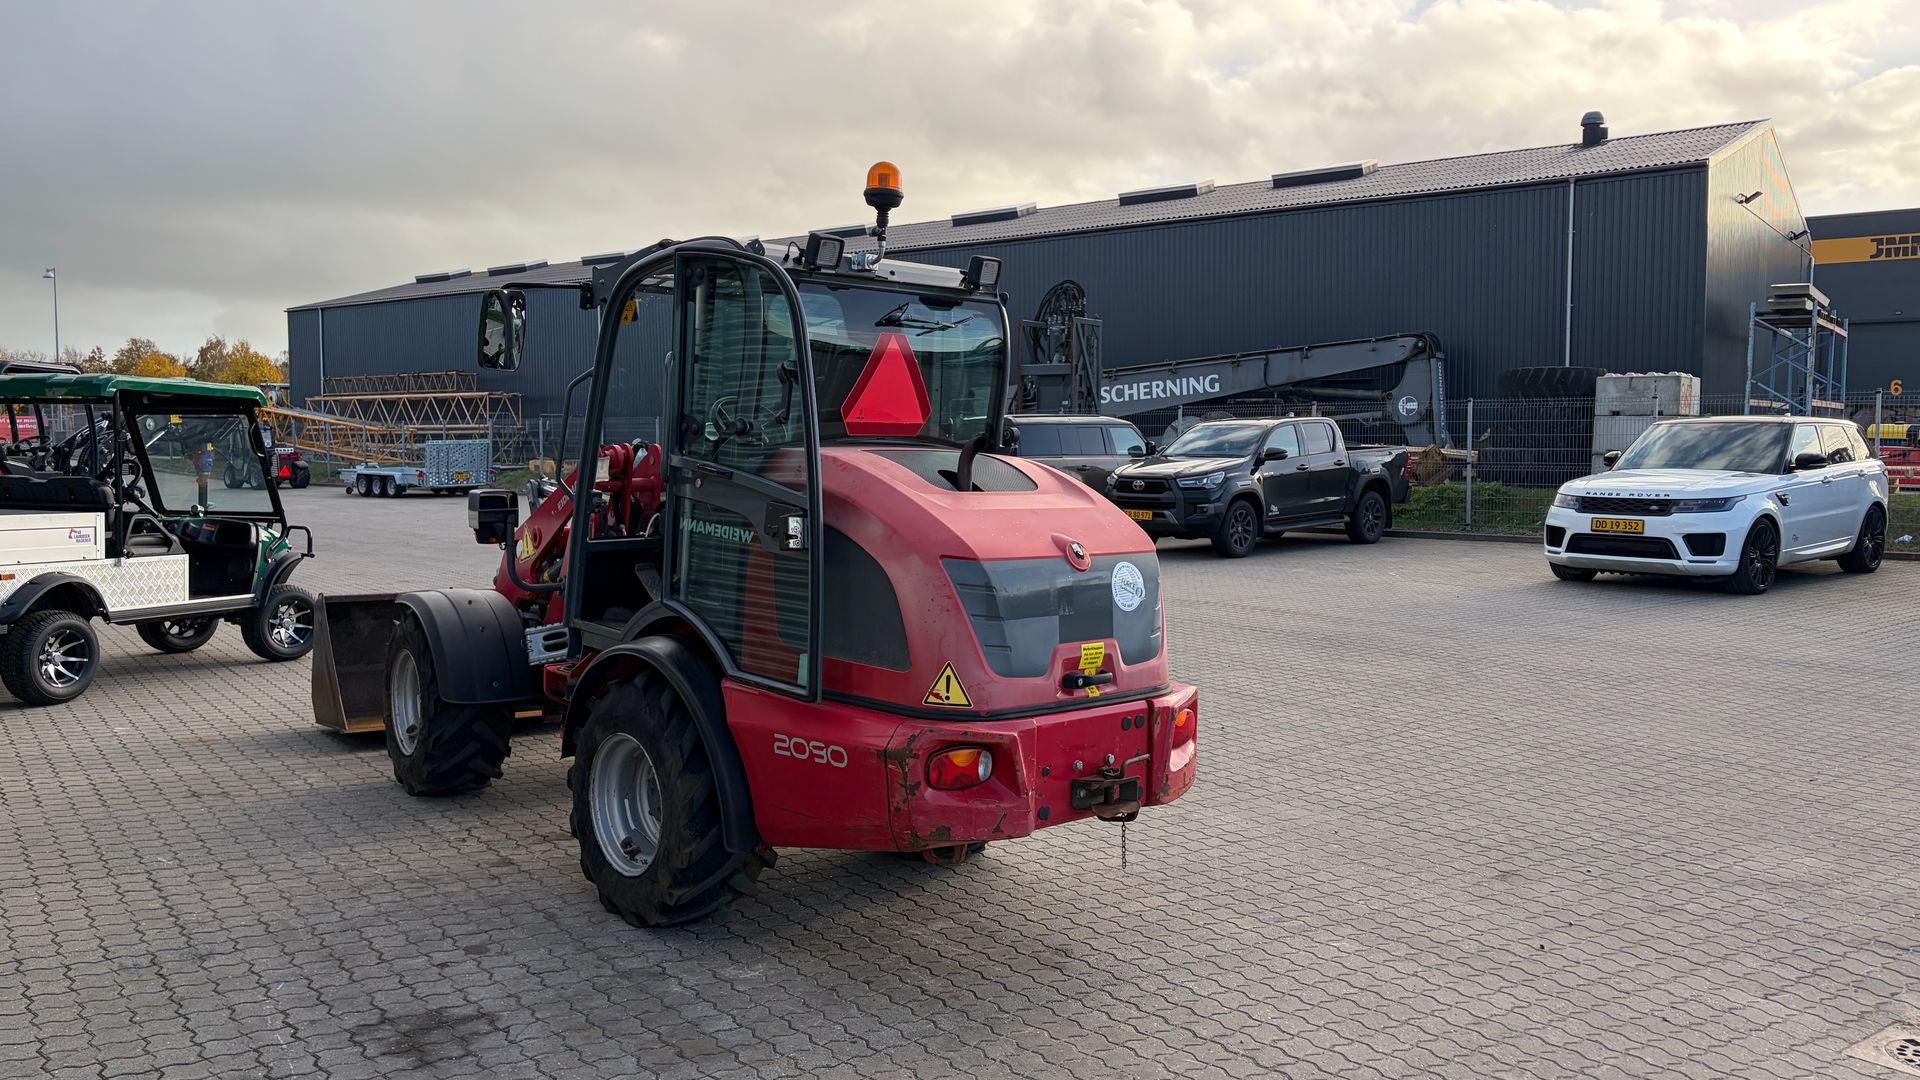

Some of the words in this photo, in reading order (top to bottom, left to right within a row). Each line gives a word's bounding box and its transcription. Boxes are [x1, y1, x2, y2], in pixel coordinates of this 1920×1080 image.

[1890, 379, 1903, 396] 6
[1595, 520, 1607, 529] DD
[1610, 520, 1620, 529] 19
[1622, 521, 1639, 530] 352
[773, 732, 848, 768] 2090
